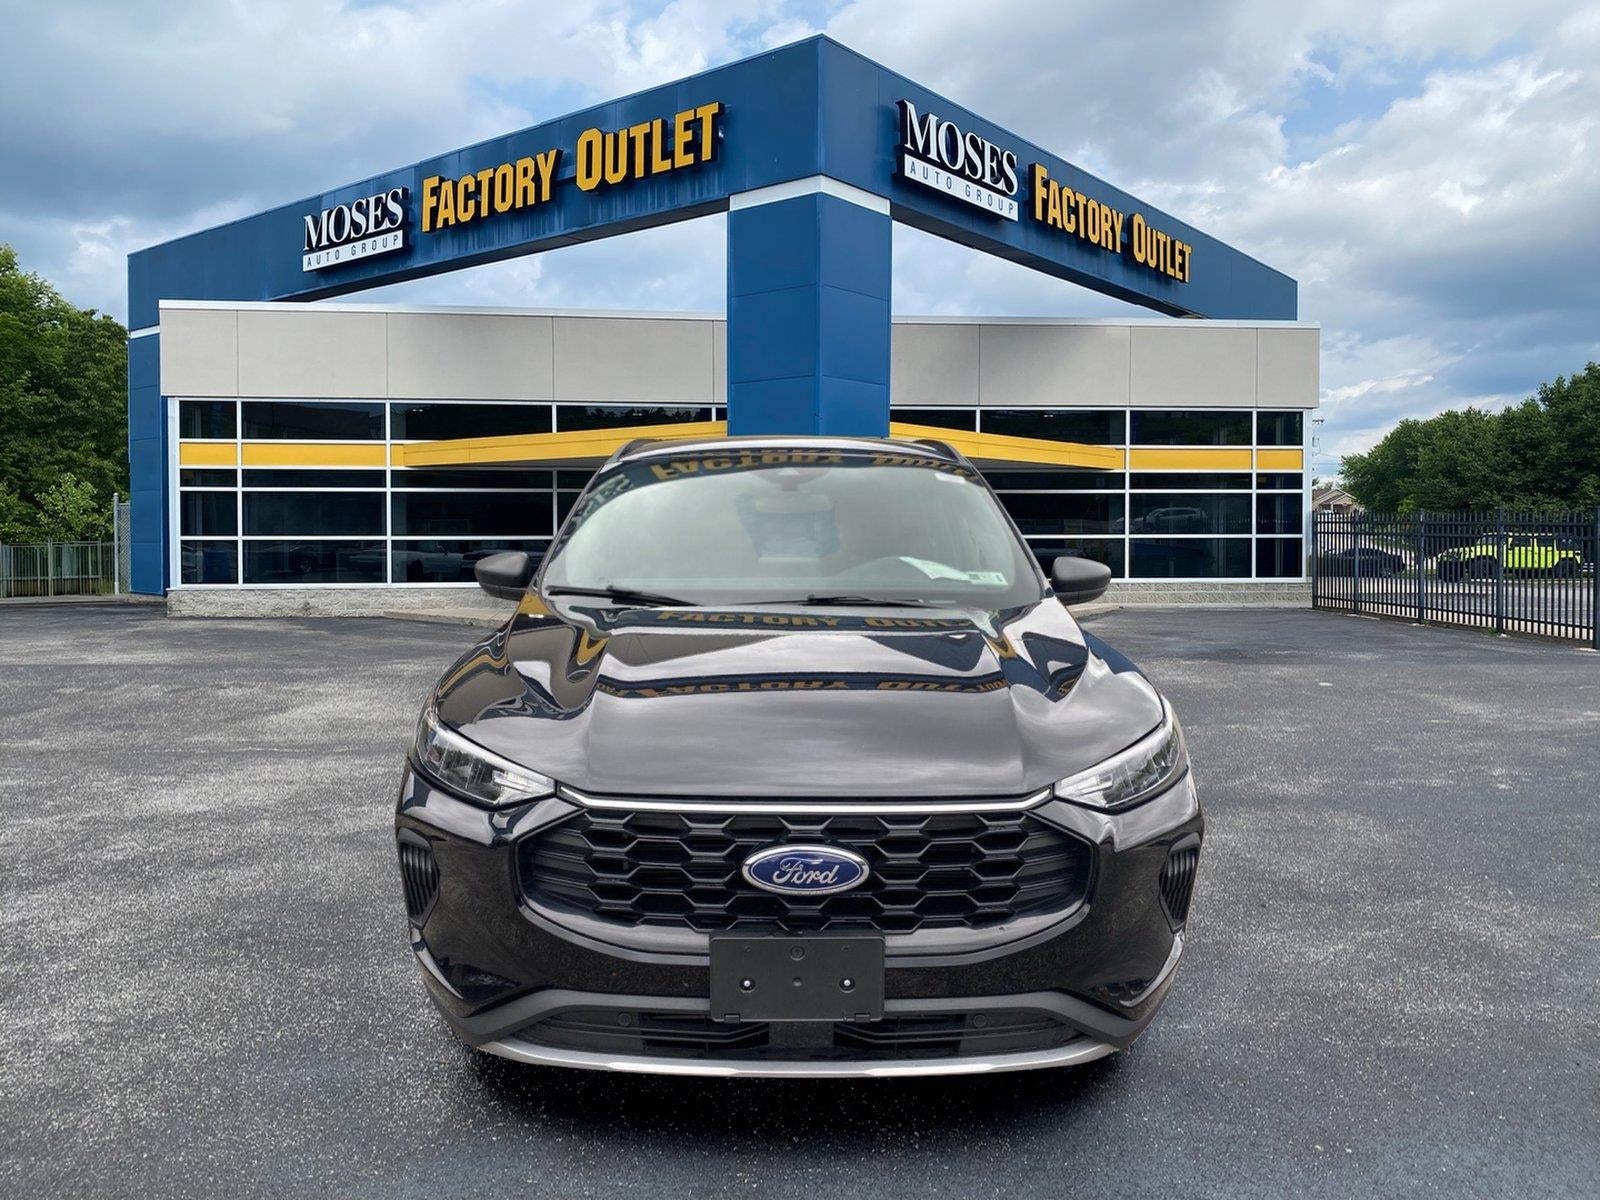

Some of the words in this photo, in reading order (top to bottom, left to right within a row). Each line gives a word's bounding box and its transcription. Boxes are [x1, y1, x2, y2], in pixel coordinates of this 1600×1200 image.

[422, 149, 558, 232] FACTORY
[576, 101, 720, 191] OUTLET
[904, 100, 1018, 195] MOSES
[910, 160, 952, 190] AUTO
[965, 183, 1014, 214] GROUP
[303, 188, 403, 251] MOSES
[307, 248, 340, 267] AUTO
[351, 234, 399, 256] GROUP
[1034, 163, 1123, 253] FACTORY
[1133, 213, 1192, 282] OUTLET
[772, 856, 840, 884] Ford
